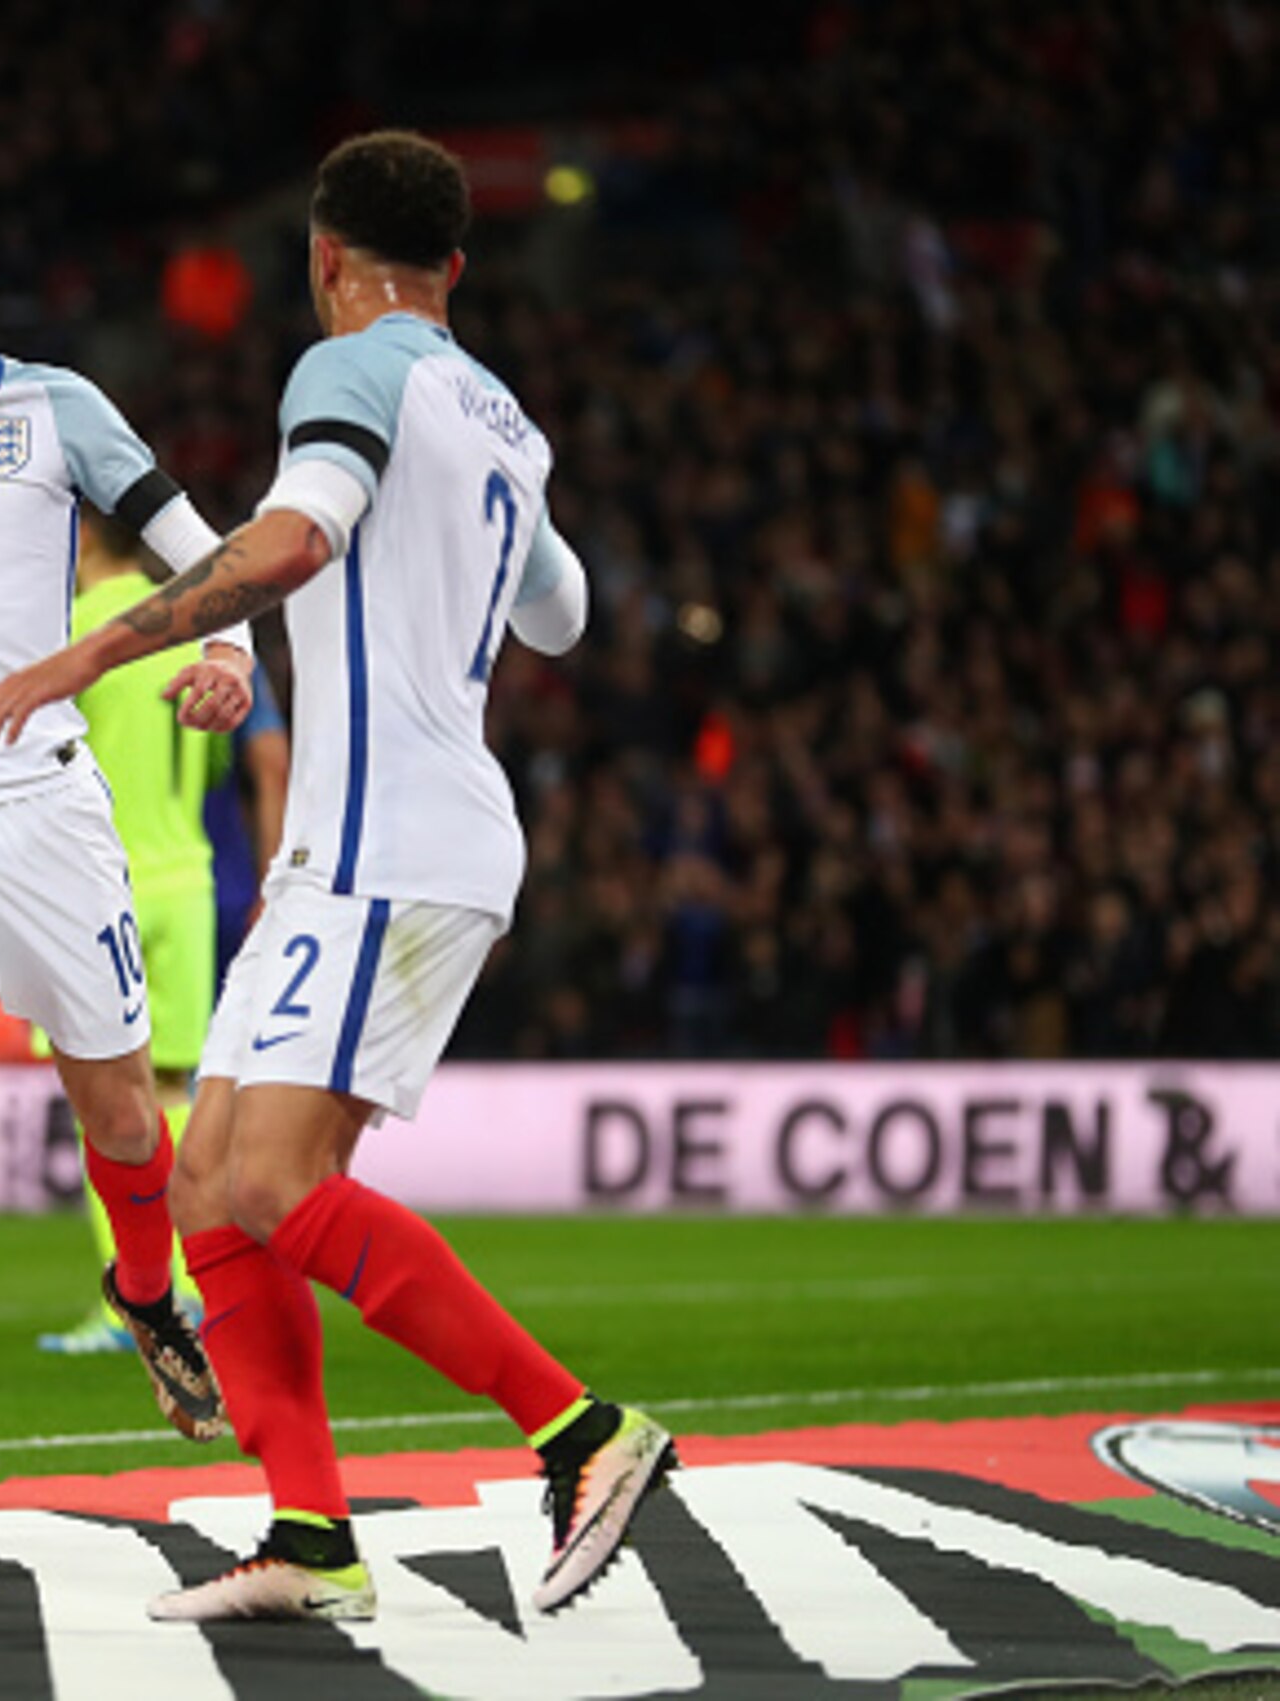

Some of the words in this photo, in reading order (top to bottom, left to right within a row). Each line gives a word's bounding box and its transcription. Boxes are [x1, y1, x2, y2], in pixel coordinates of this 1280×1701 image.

[96, 911, 143, 998] 10
[269, 933, 321, 1018] 2
[583, 1099, 730, 1203] DE
[773, 1099, 1110, 1203] COEN
[1146, 1088, 1238, 1210] &
